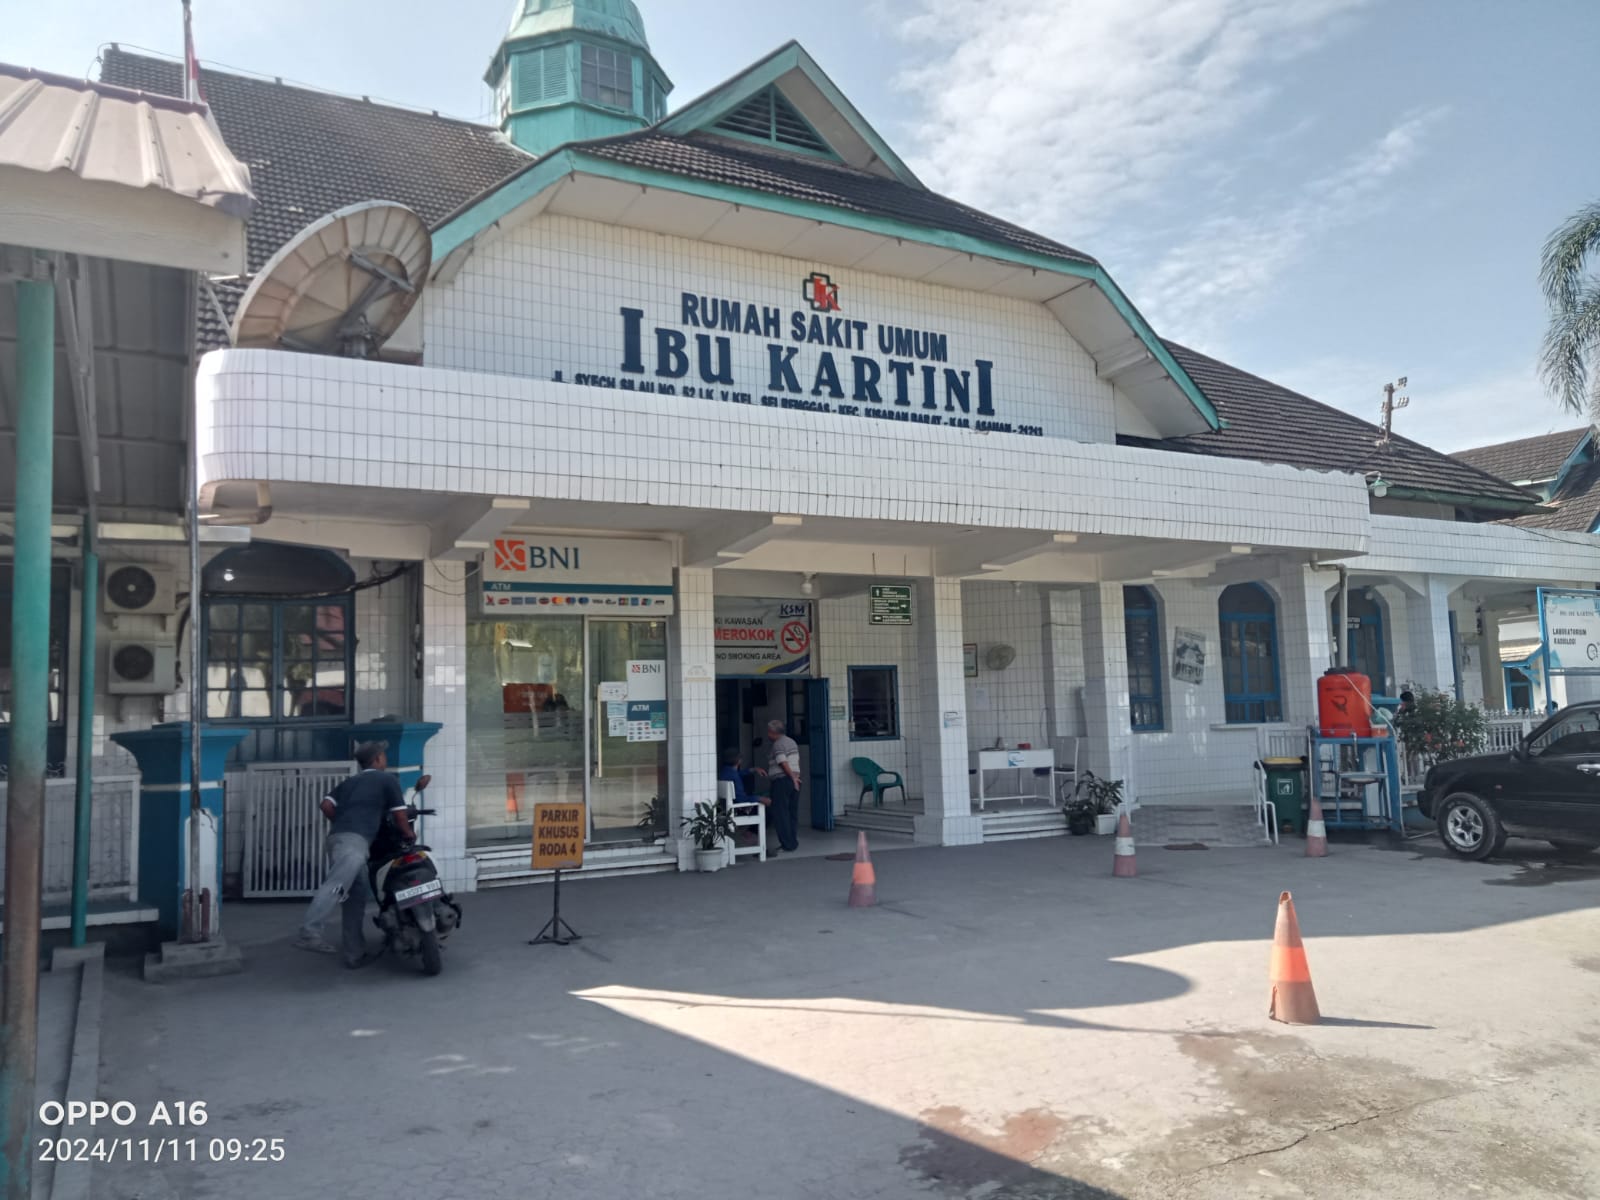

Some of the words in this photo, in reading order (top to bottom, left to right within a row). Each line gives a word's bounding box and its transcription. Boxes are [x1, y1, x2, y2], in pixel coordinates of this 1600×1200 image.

[681, 292, 780, 338] RUMAH
[791, 311, 868, 350] SAKIT
[878, 324, 948, 362] UMUM
[620, 307, 734, 386] IBU
[767, 343, 995, 416] KARTINI
[530, 546, 580, 570] BNI
[491, 583, 511, 591] ATM
[780, 603, 805, 615] KSM
[724, 617, 763, 625] KAWASAN
[714, 628, 775, 640] MEROKOK
[642, 664, 660, 673] BNI
[541, 809, 579, 822] PARKIR
[539, 826, 579, 839] KHUSUS
[539, 843, 567, 856] RODA
[570, 842, 577, 856] 4
